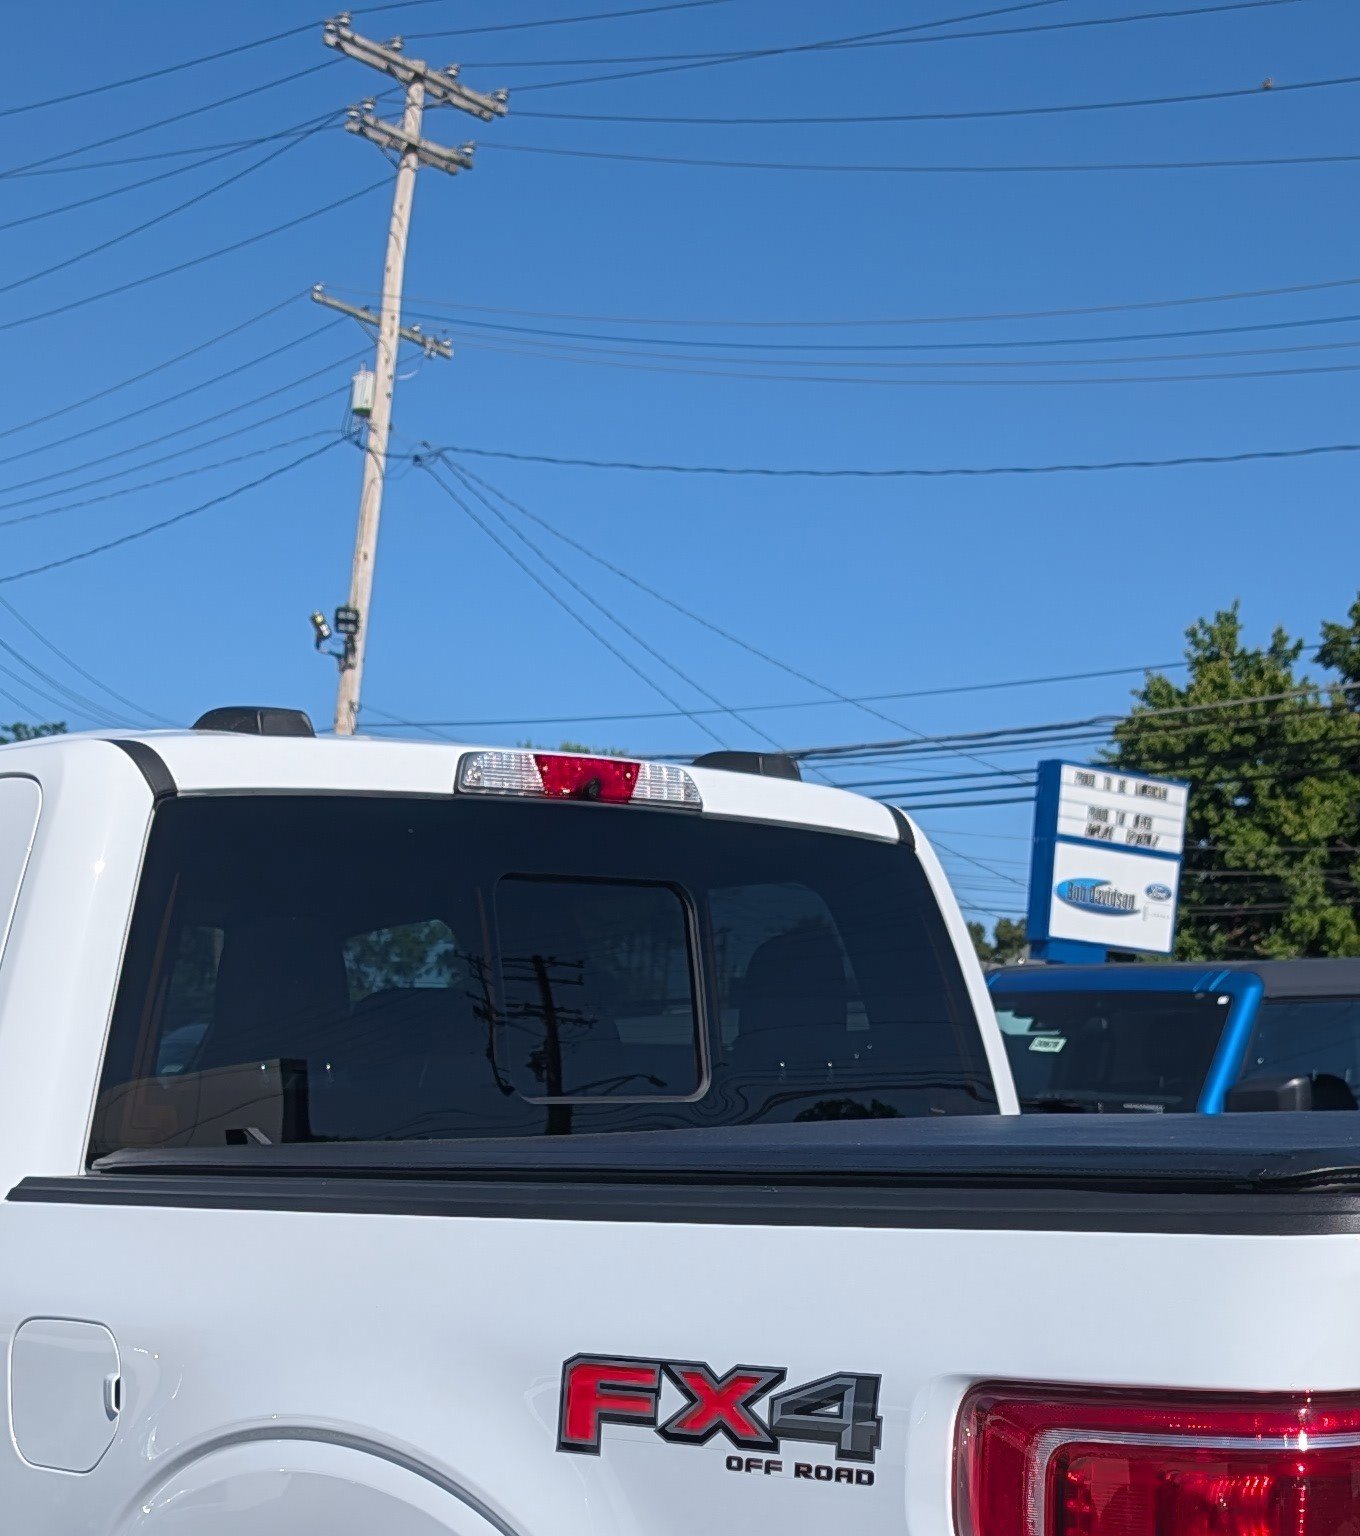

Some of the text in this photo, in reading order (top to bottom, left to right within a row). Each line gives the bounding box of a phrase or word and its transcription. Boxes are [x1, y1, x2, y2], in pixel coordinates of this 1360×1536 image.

[555, 1352, 883, 1464] FX4
[725, 1455, 875, 1487] OFF ROAD
